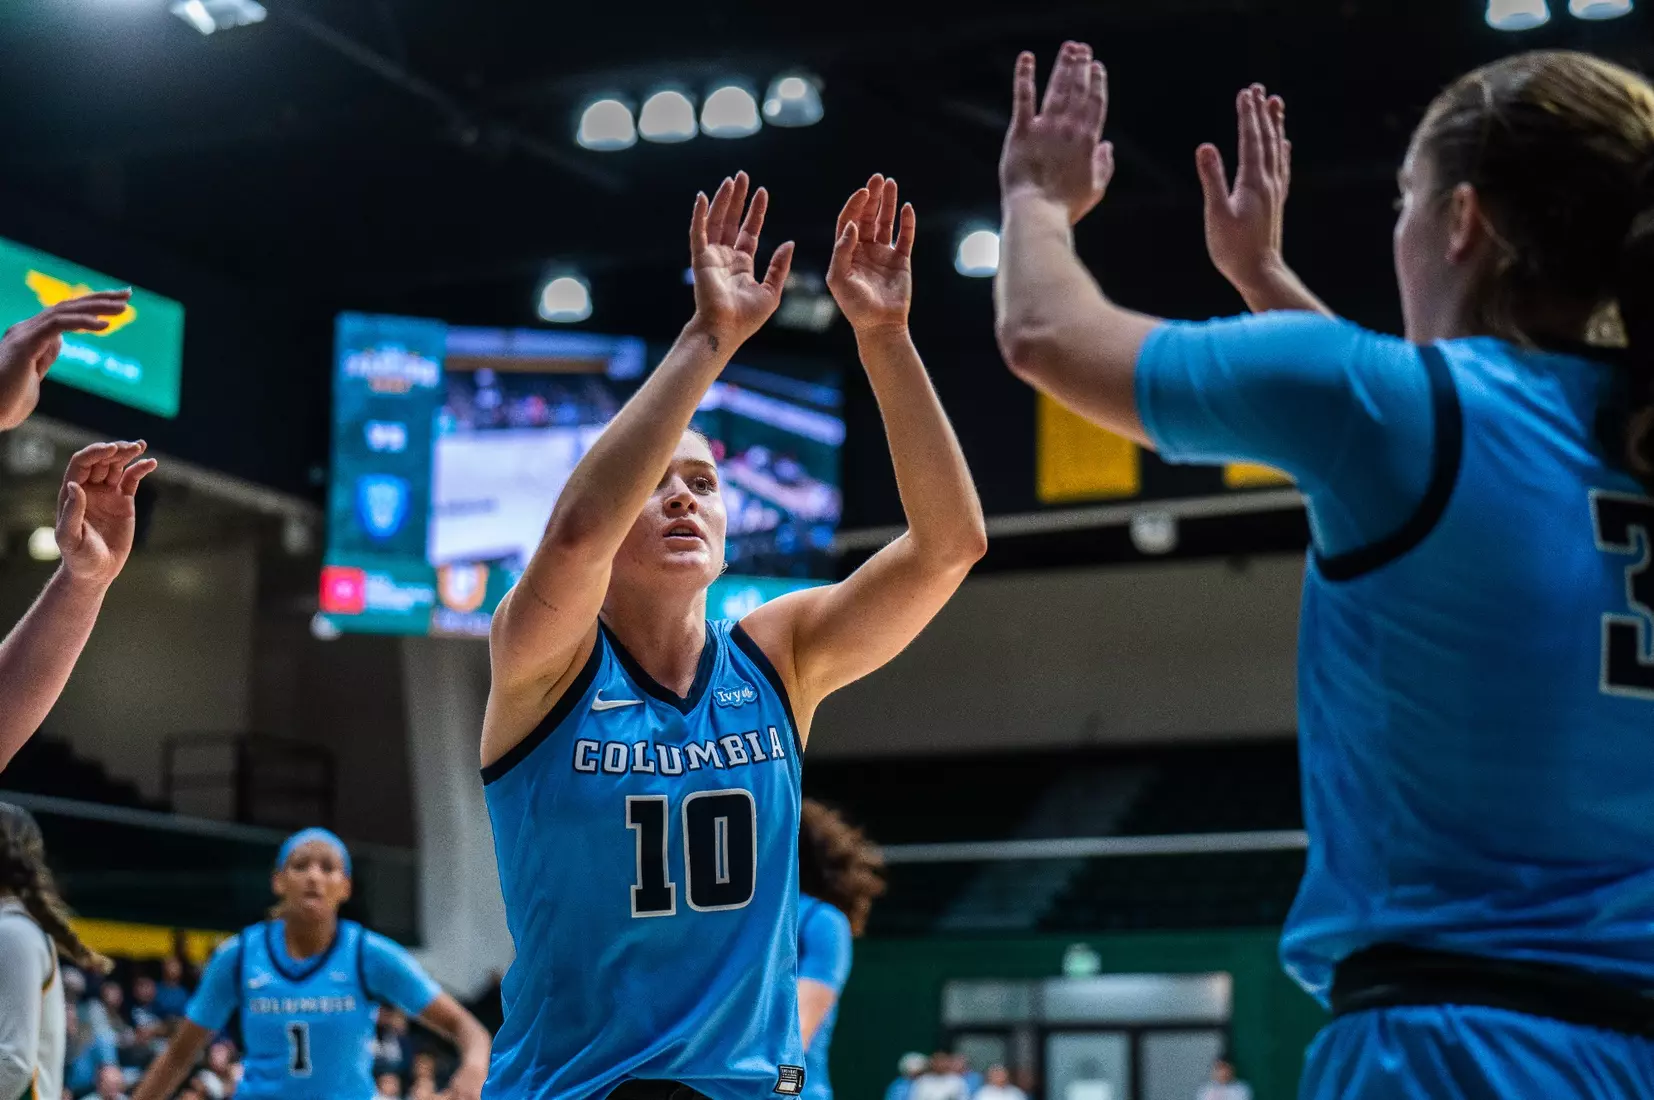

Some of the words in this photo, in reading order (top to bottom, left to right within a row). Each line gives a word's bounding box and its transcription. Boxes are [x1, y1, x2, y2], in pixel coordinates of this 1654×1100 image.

[717, 690, 741, 702] Ivy
[573, 725, 786, 776] COLUMBIA
[625, 788, 757, 918] 10
[286, 1020, 313, 1078] 1
